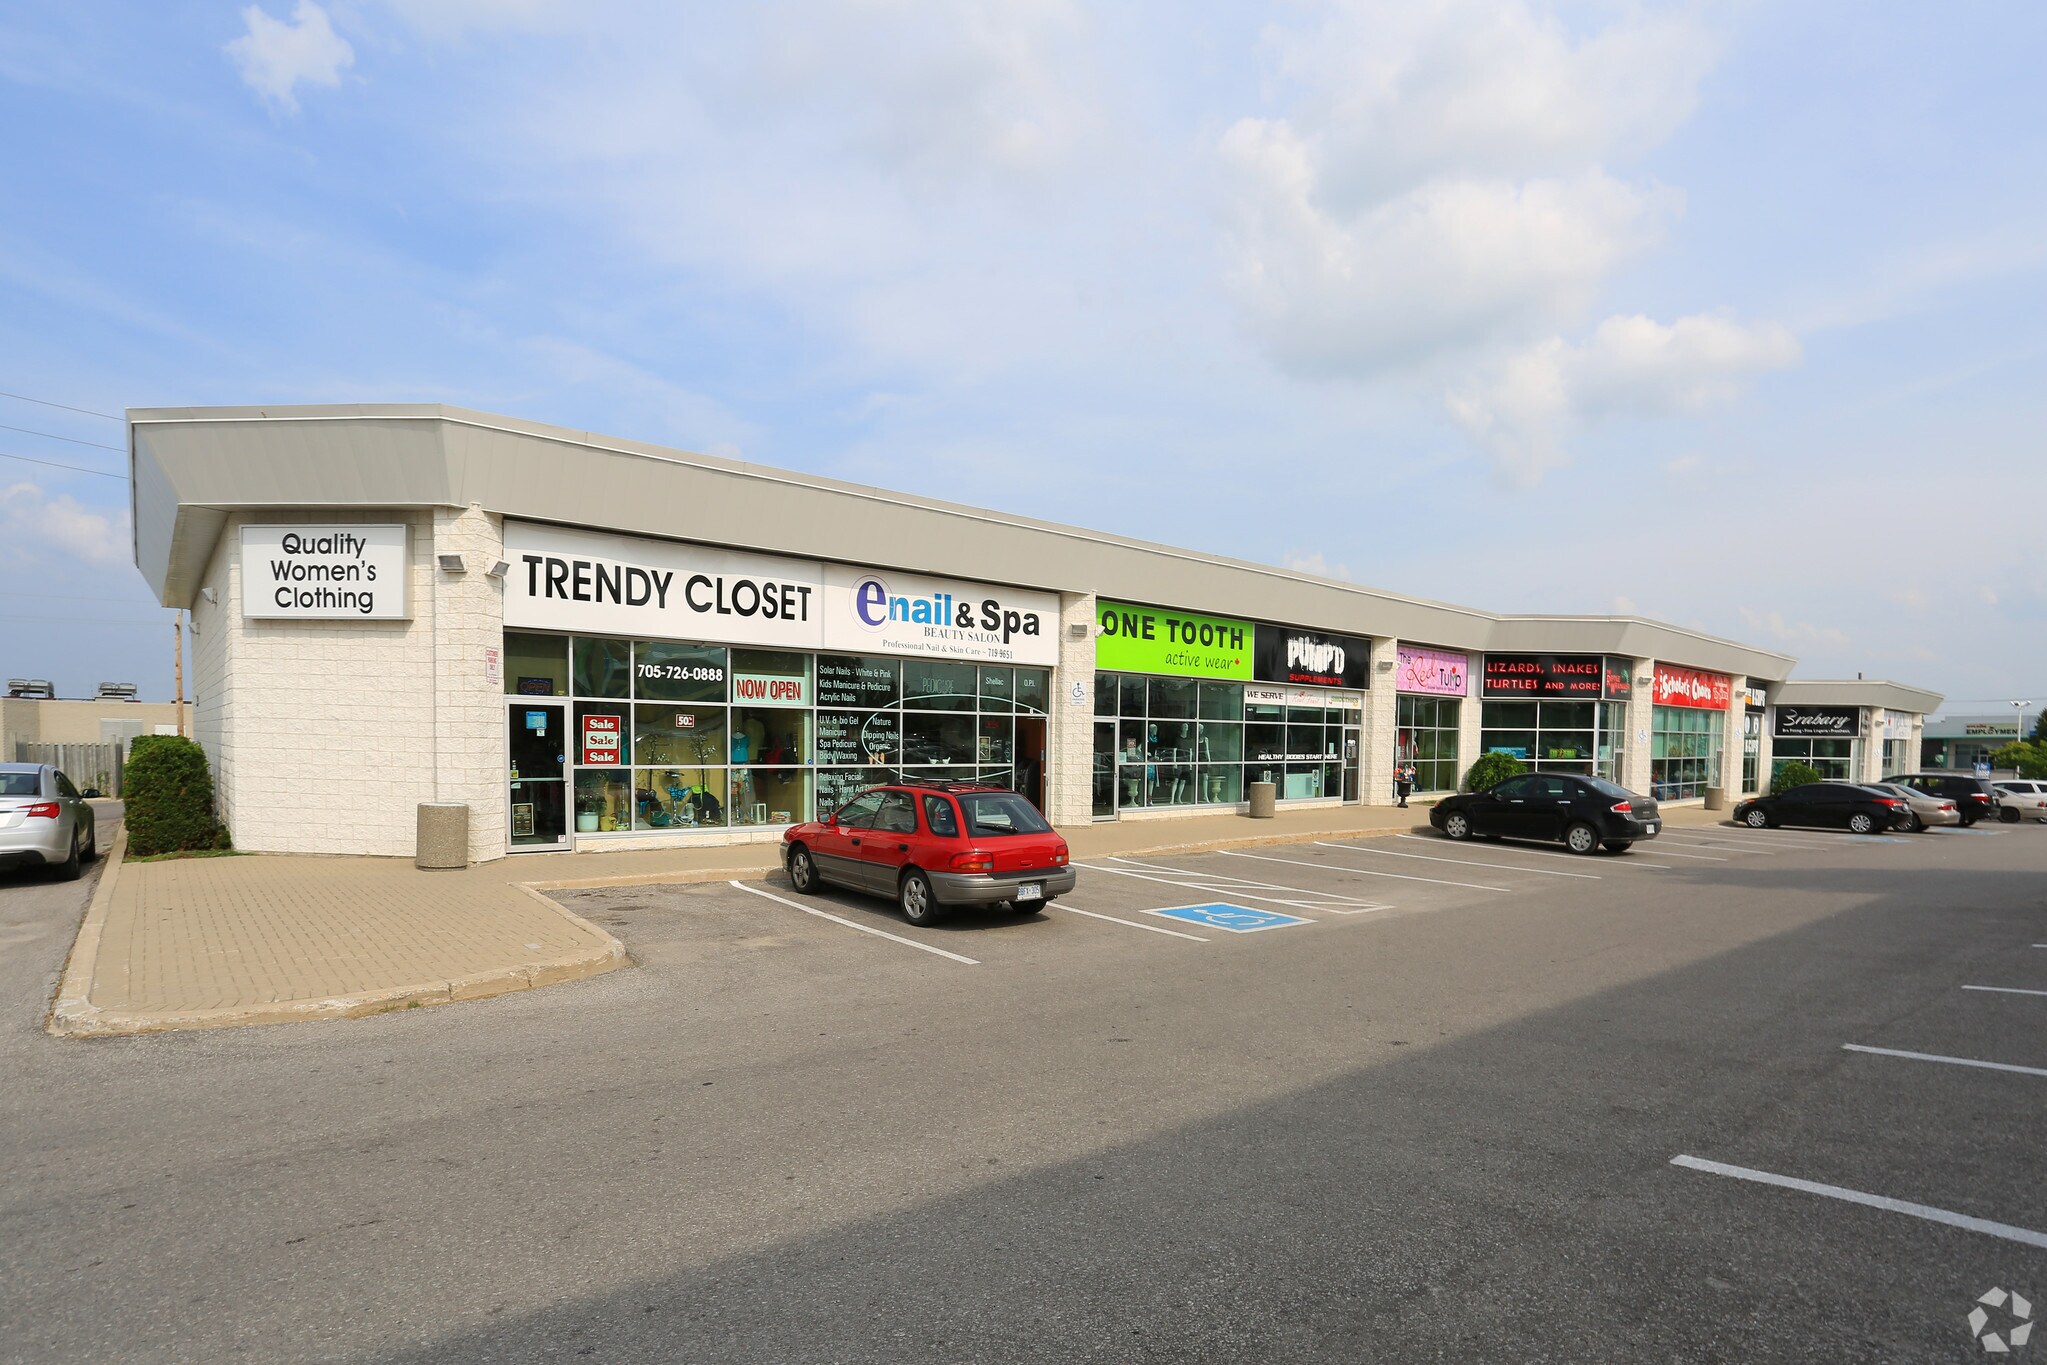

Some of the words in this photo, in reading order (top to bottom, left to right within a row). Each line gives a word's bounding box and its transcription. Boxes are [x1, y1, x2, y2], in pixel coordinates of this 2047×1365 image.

[282, 533, 366, 558] Quality
[271, 560, 376, 581] Women's
[522, 555, 673, 608] TRENDY
[685, 575, 811, 621] CLOSET
[275, 587, 373, 613] Clothing
[955, 602, 975, 628] &
[981, 600, 1040, 644] Spa
[924, 627, 965, 640] BEAUTY
[968, 631, 1000, 643] SALON
[1102, 610, 1155, 640] ONE
[1166, 619, 1243, 650] TOOTH
[882, 639, 924, 651] Professional
[926, 643, 940, 652] Nail
[949, 645, 964, 654] Skin
[965, 647, 981, 656] Care
[988, 648, 1013, 659] 719-9651
[1166, 650, 1200, 667] active
[1205, 656, 1233, 670] wear
[1399, 652, 1411, 664] The
[637, 665, 723, 682] 705-726-0888
[820, 665, 834, 674] Solar
[836, 666, 850, 676] Nails
[856, 667, 872, 677] White
[874, 669, 878, 677] &
[880, 669, 891, 678] Pink
[1406, 653, 1436, 689] Red
[1487, 663, 1544, 674] LIZARDS,
[1552, 664, 1599, 674] SNAKES
[820, 679, 832, 688] Kids
[833, 680, 860, 690] Manicure
[861, 681, 866, 690] &
[867, 682, 891, 691] Pedicure
[985, 677, 1004, 686] Shellac
[1289, 673, 1342, 685] SUPPLEMENTS
[1486, 679, 1538, 689] TURTLES
[737, 679, 767, 699] NOW
[770, 680, 801, 700] OPEN
[1247, 690, 1259, 699] WE
[1261, 691, 1284, 700] SERVE
[820, 692, 840, 702] Acrylic
[842, 693, 856, 702] Nails
[589, 719, 614, 729] Sale
[840, 715, 848, 724] bio
[849, 715, 858, 724] Gel
[872, 717, 891, 726] Nature
[820, 727, 846, 736] Manicure
[863, 730, 885, 741] Dipping
[886, 731, 899, 740] Nails
[1966, 726, 2022, 735] EMPLOYMEN
[590, 736, 614, 745] Sale
[820, 739, 830, 749] Spa
[832, 739, 857, 748] Pedicure
[869, 742, 890, 752] Organic
[589, 752, 614, 762] Sale
